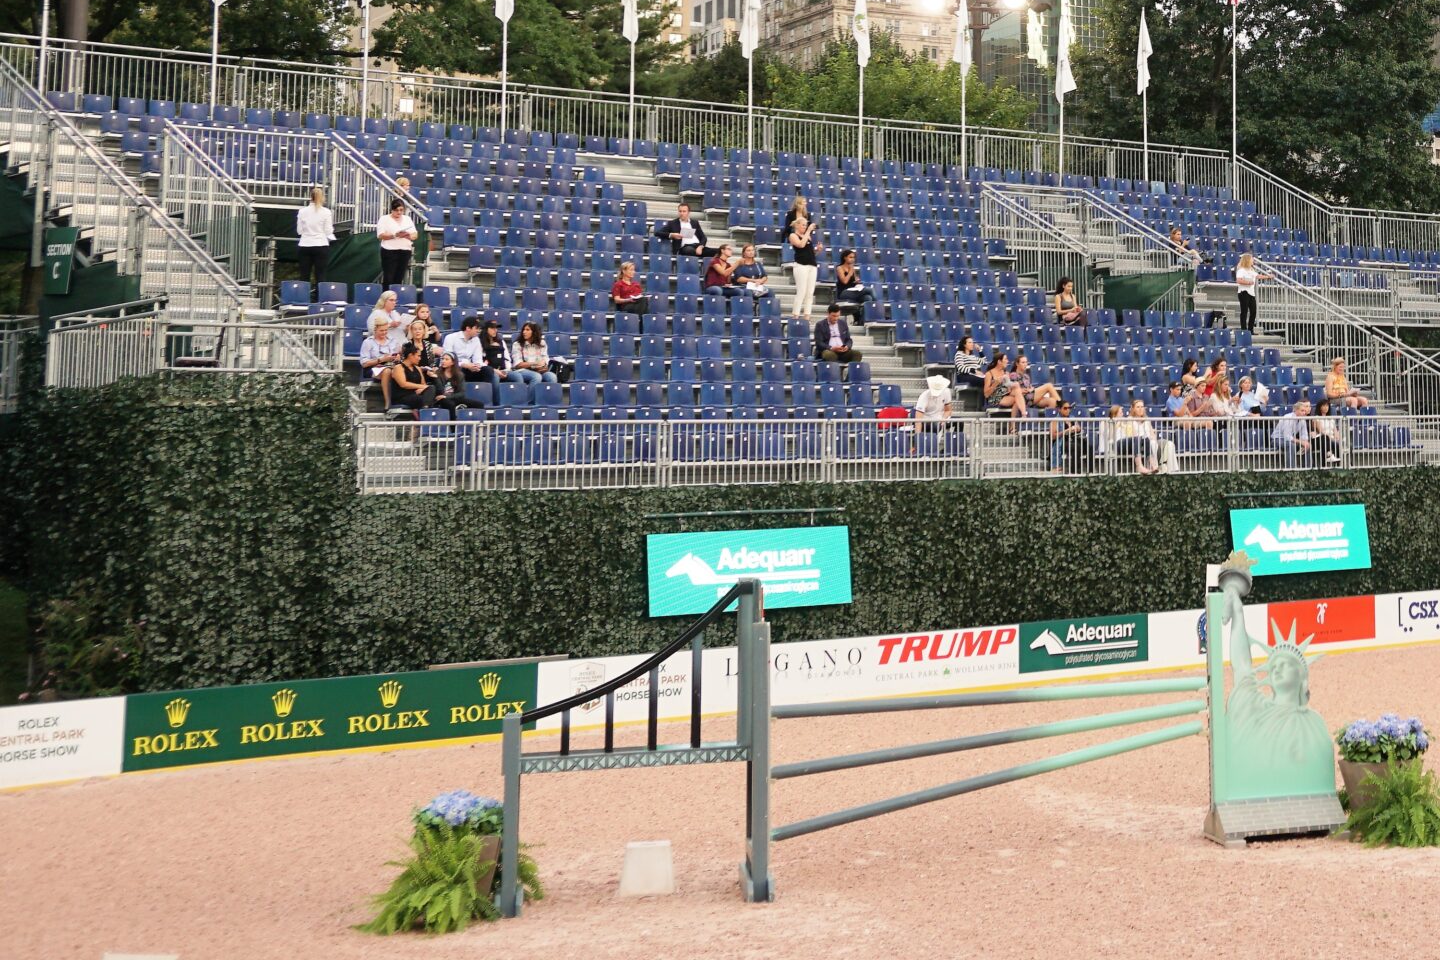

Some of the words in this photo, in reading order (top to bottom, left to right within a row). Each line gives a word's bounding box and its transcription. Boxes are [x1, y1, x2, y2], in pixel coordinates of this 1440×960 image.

[46, 243, 73, 256] SECTION
[52, 261, 61, 280] C
[1408, 600, 1439, 620] CSX
[877, 628, 1017, 665] TRUMP
[725, 647, 863, 677] LGANO
[875, 670, 915, 682] CENTRAL
[918, 669, 938, 679] PARK
[954, 663, 995, 674] WOLLMAN
[997, 661, 1017, 671] RINK
[661, 674, 687, 685] PARK
[616, 690, 650, 702] HORSE
[658, 688, 683, 698] HOW
[347, 709, 430, 735] ROLEX
[449, 700, 527, 724] ROLEX
[18, 716, 60, 731] ROLEX
[240, 719, 325, 745] ROLEX
[0, 732, 48, 748] ENTRAL
[52, 728, 86, 742] PARK
[132, 728, 220, 757] ROLEX
[40, 744, 79, 759] SHOW
